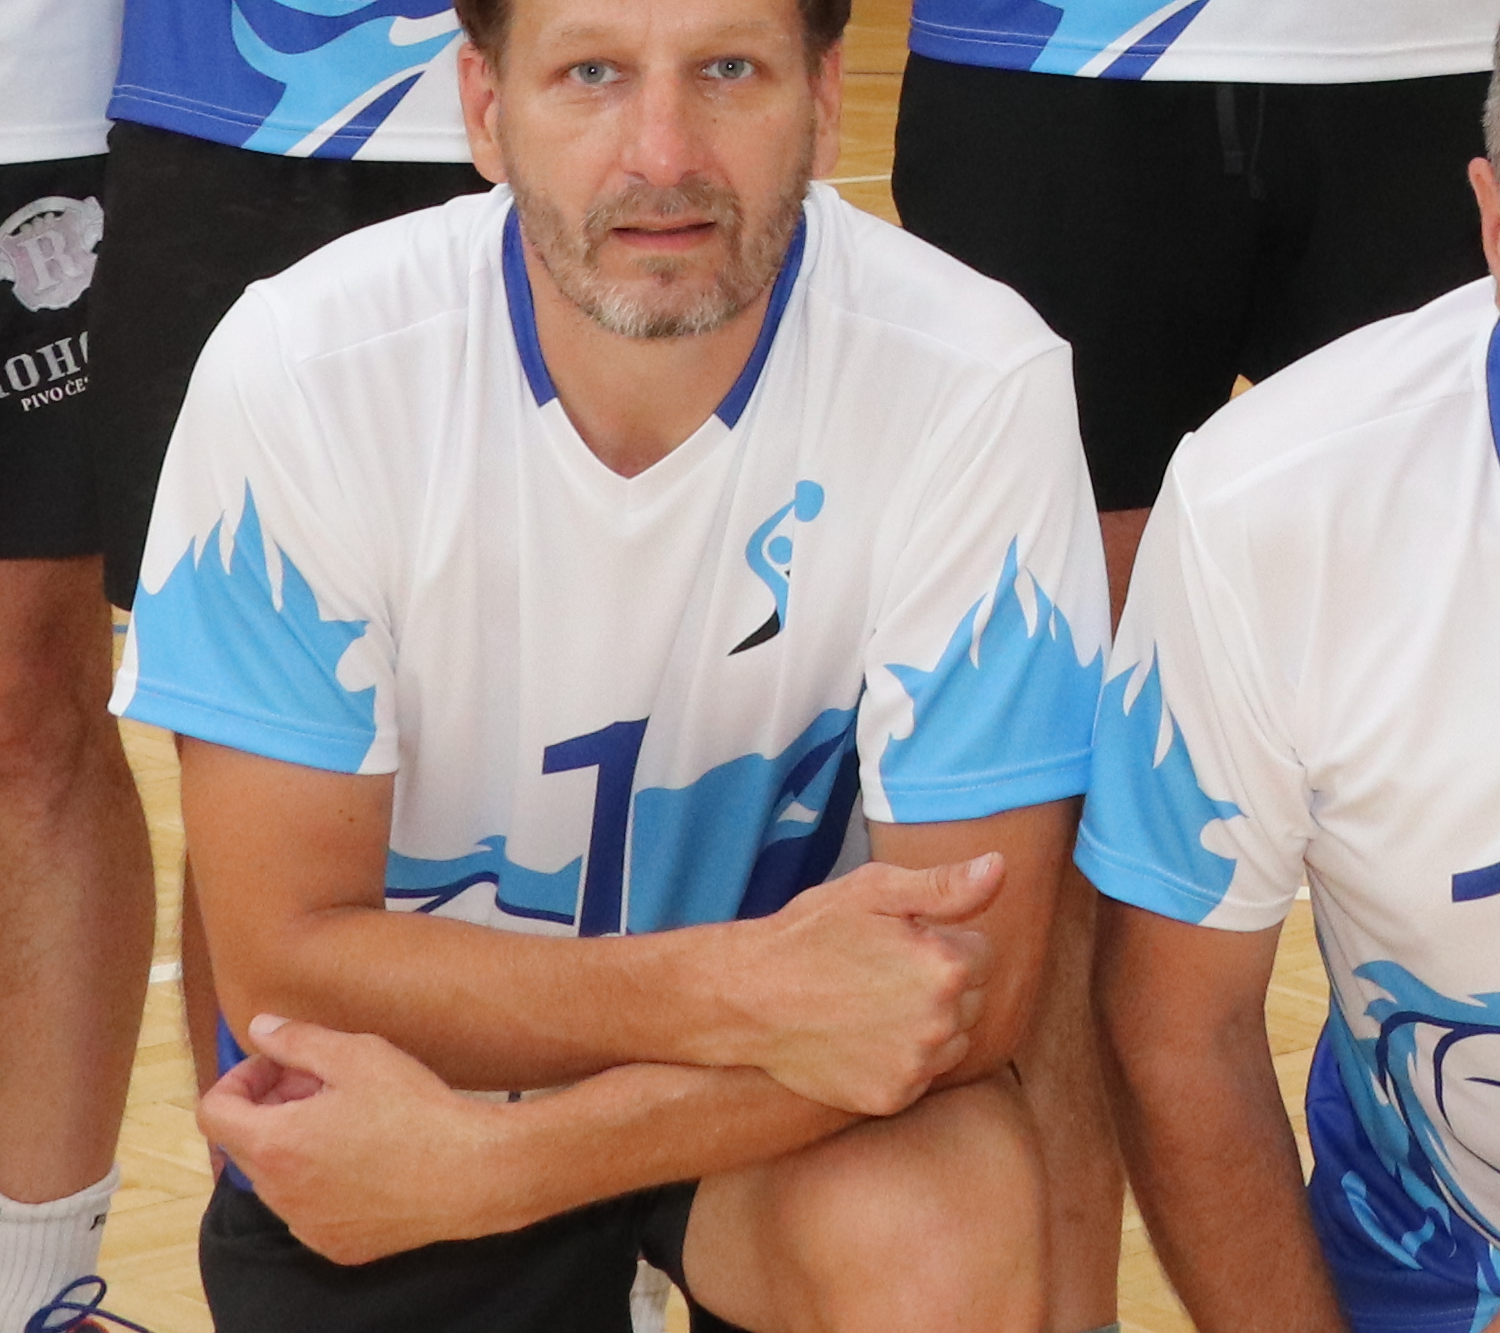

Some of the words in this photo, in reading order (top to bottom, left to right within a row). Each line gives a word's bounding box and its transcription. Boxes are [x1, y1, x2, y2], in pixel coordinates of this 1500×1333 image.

[20, 386, 64, 412] PIVO
[65, 376, 89, 397] ČE
[542, 714, 651, 937] 1
